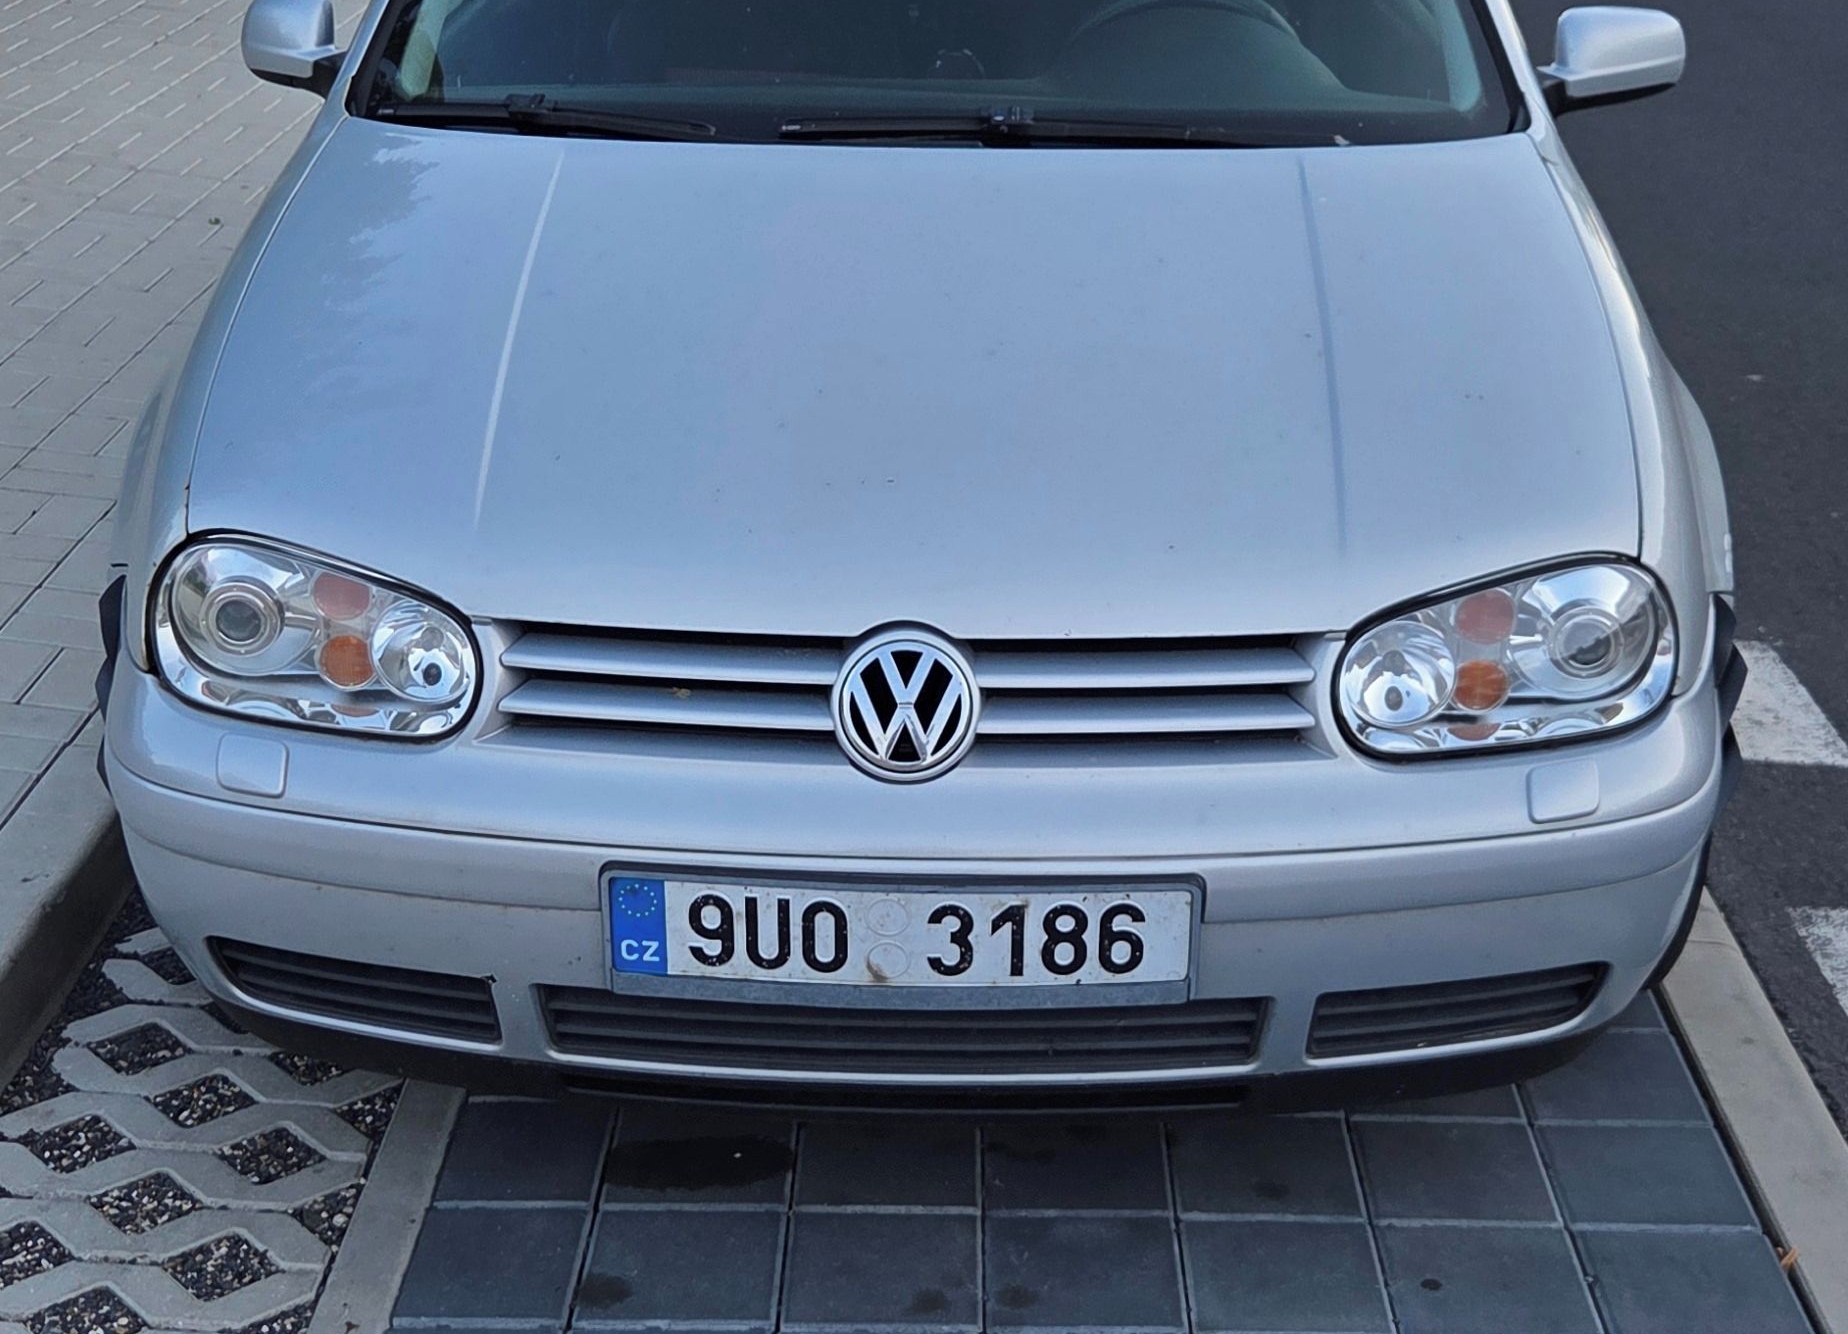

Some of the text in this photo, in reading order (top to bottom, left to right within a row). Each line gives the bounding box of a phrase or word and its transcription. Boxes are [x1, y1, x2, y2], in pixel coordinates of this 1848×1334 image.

[840, 639, 973, 773] VW
[620, 893, 1147, 977] CZ 9U0 3186
